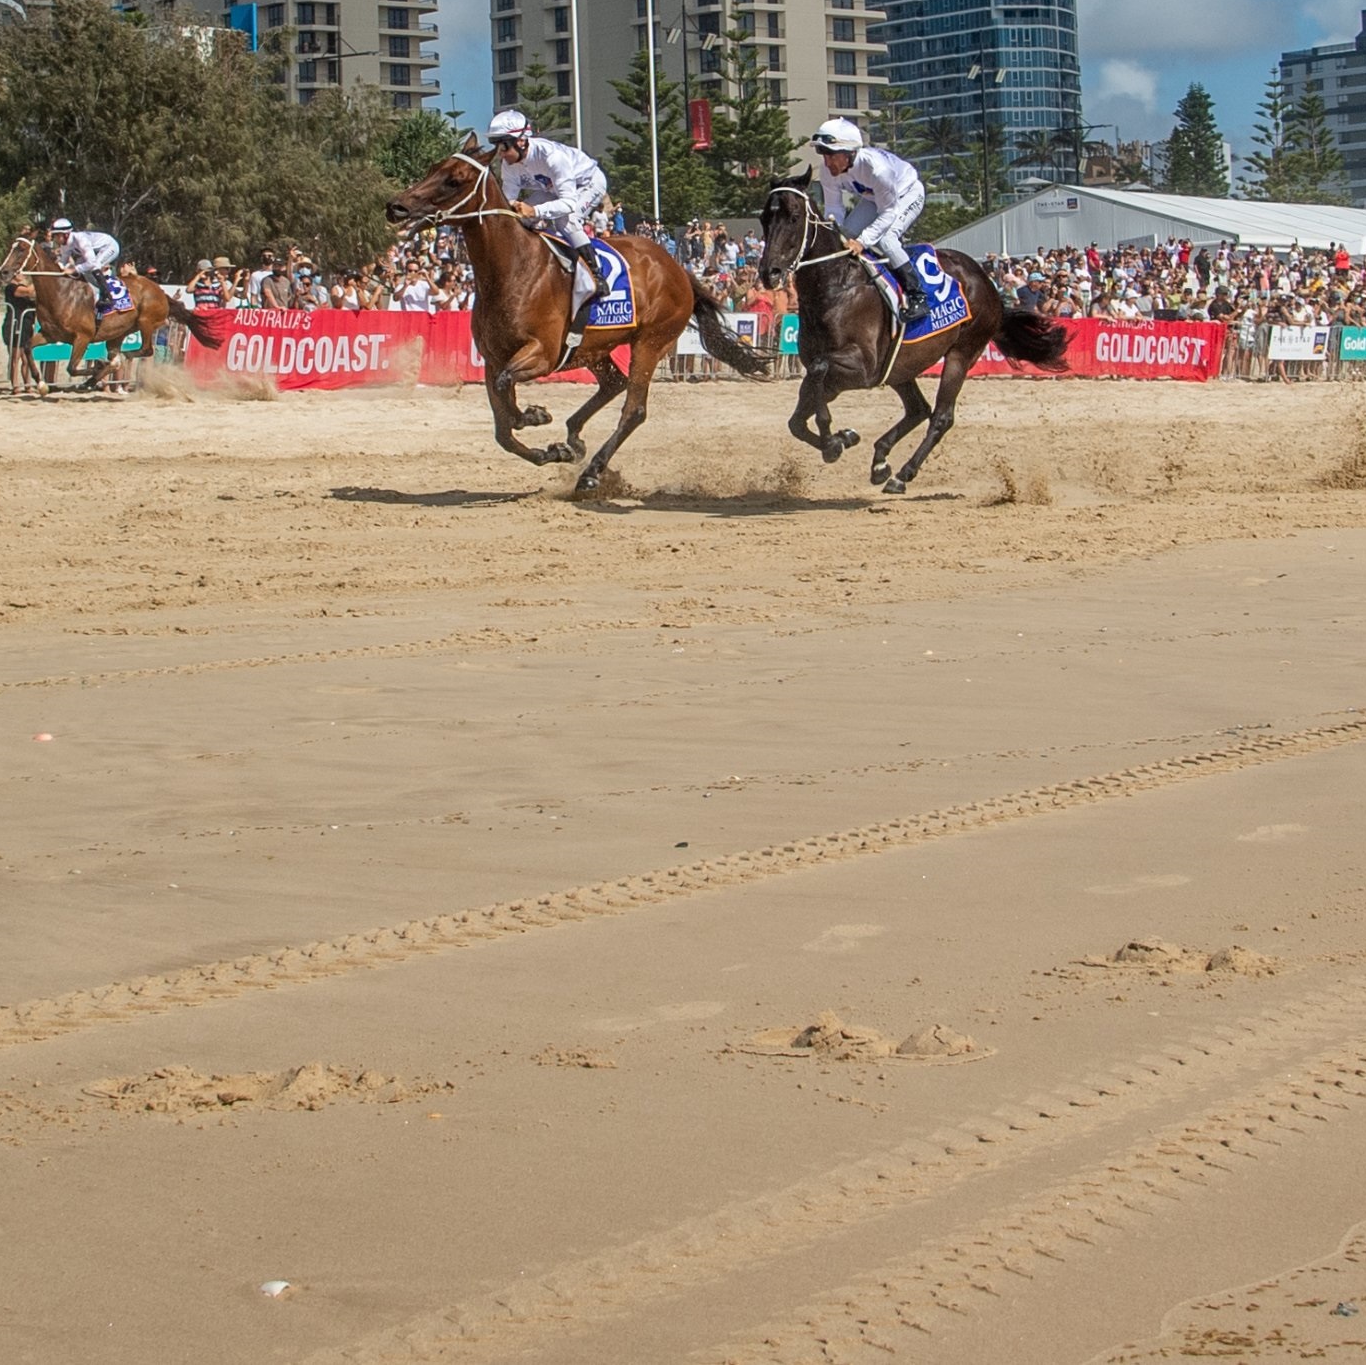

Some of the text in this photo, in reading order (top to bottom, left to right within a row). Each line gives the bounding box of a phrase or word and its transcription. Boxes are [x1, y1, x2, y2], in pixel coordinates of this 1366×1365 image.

[915, 252, 953, 302] 9
[234, 308, 312, 330] AUSTRALIA'S
[930, 296, 965, 322] MAGIC
[1344, 336, 1366, 351] Gold
